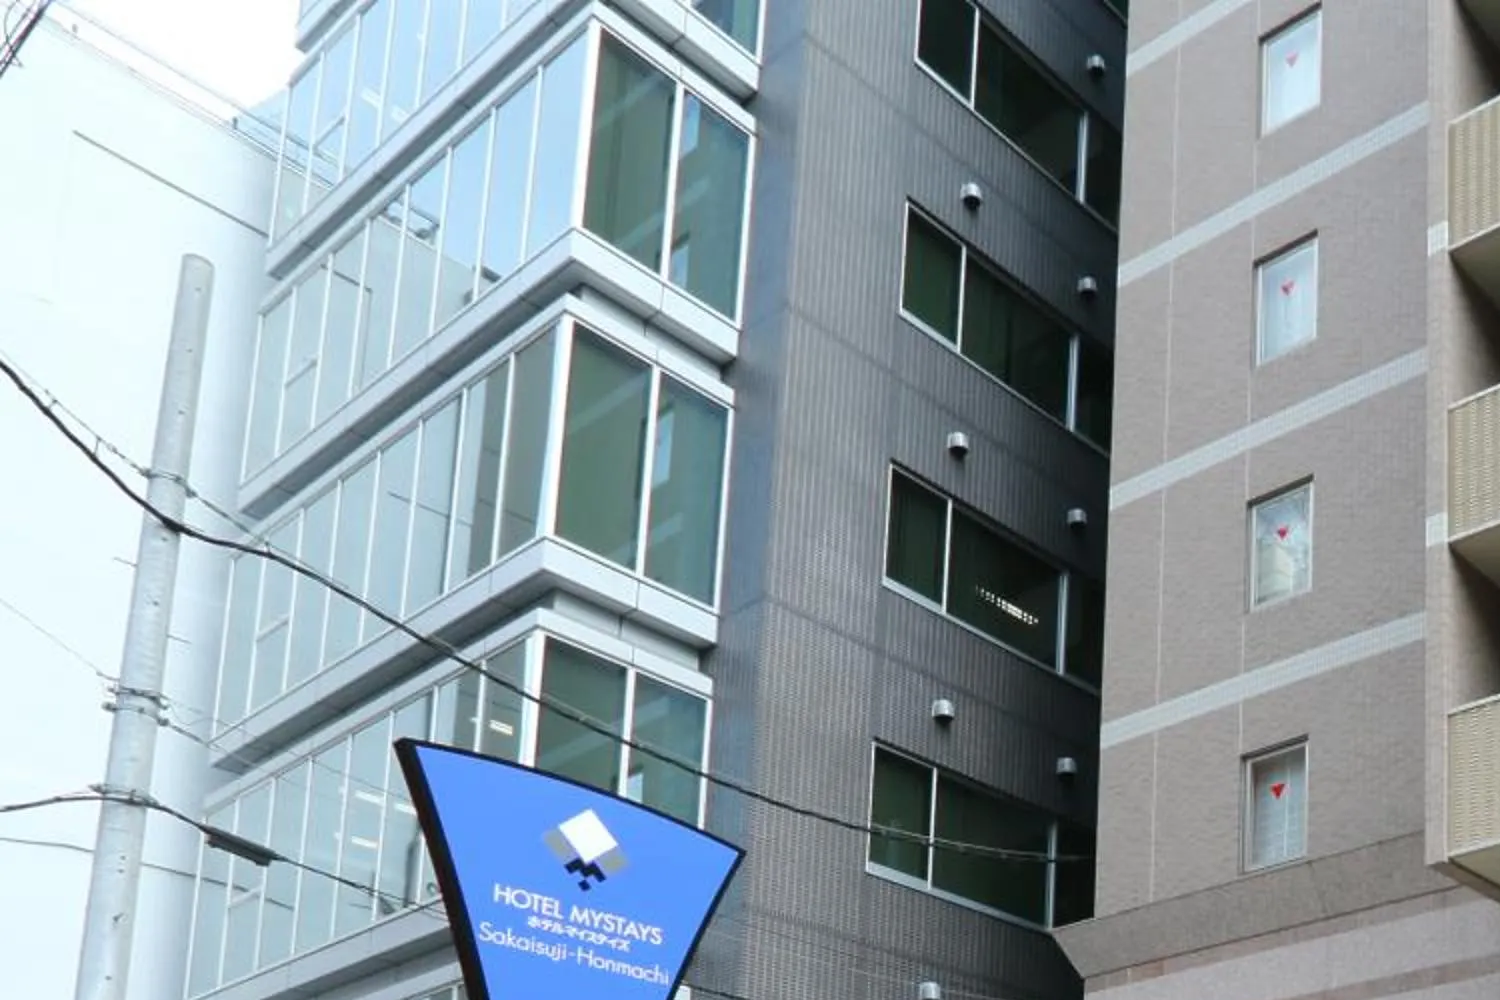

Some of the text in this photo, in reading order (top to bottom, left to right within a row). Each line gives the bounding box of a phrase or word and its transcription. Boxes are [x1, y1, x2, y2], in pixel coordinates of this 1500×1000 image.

[493, 883, 663, 946] HOTEL MYSTAYS
[479, 921, 670, 986] Sakaisuji-Honmachi
